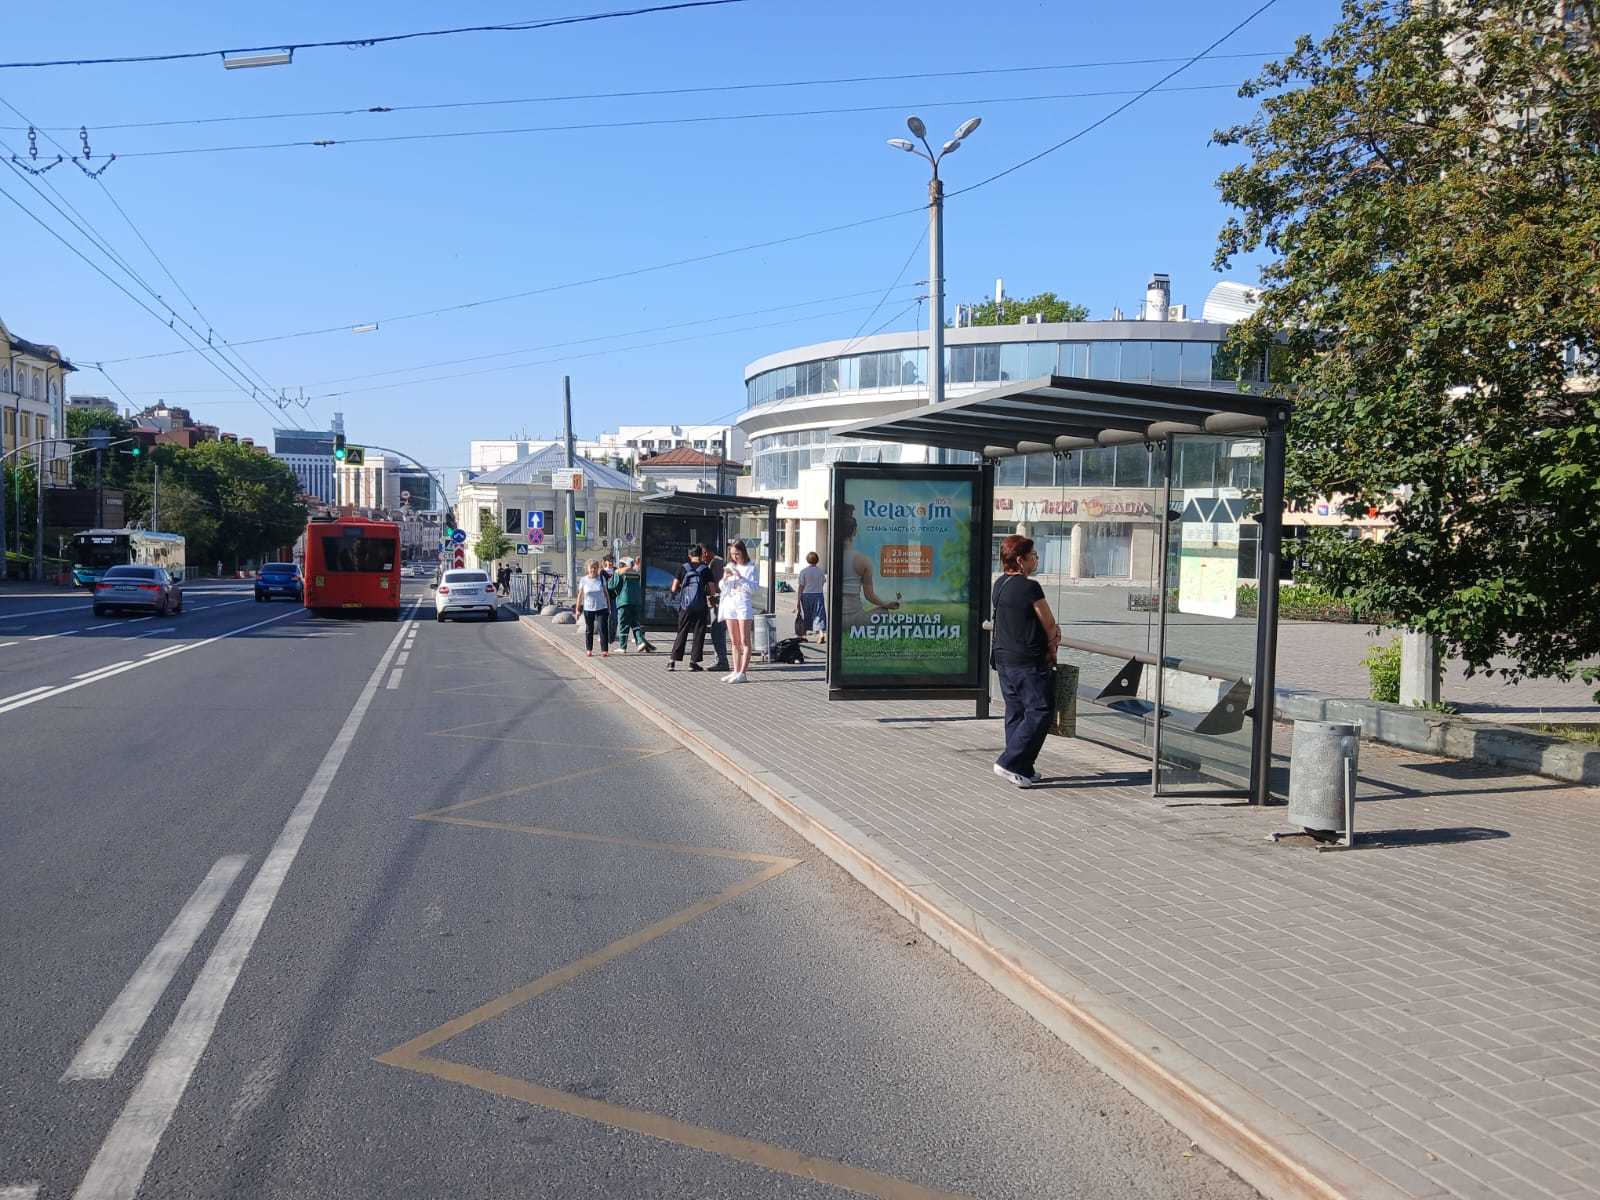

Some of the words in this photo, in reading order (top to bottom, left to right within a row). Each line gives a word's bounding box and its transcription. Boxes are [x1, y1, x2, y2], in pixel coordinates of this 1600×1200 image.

[863, 500, 915, 520] Relax
[870, 613, 941, 624] ОТКРЫТАЯ
[849, 625, 961, 640] МЕДИТАЦИЯ
